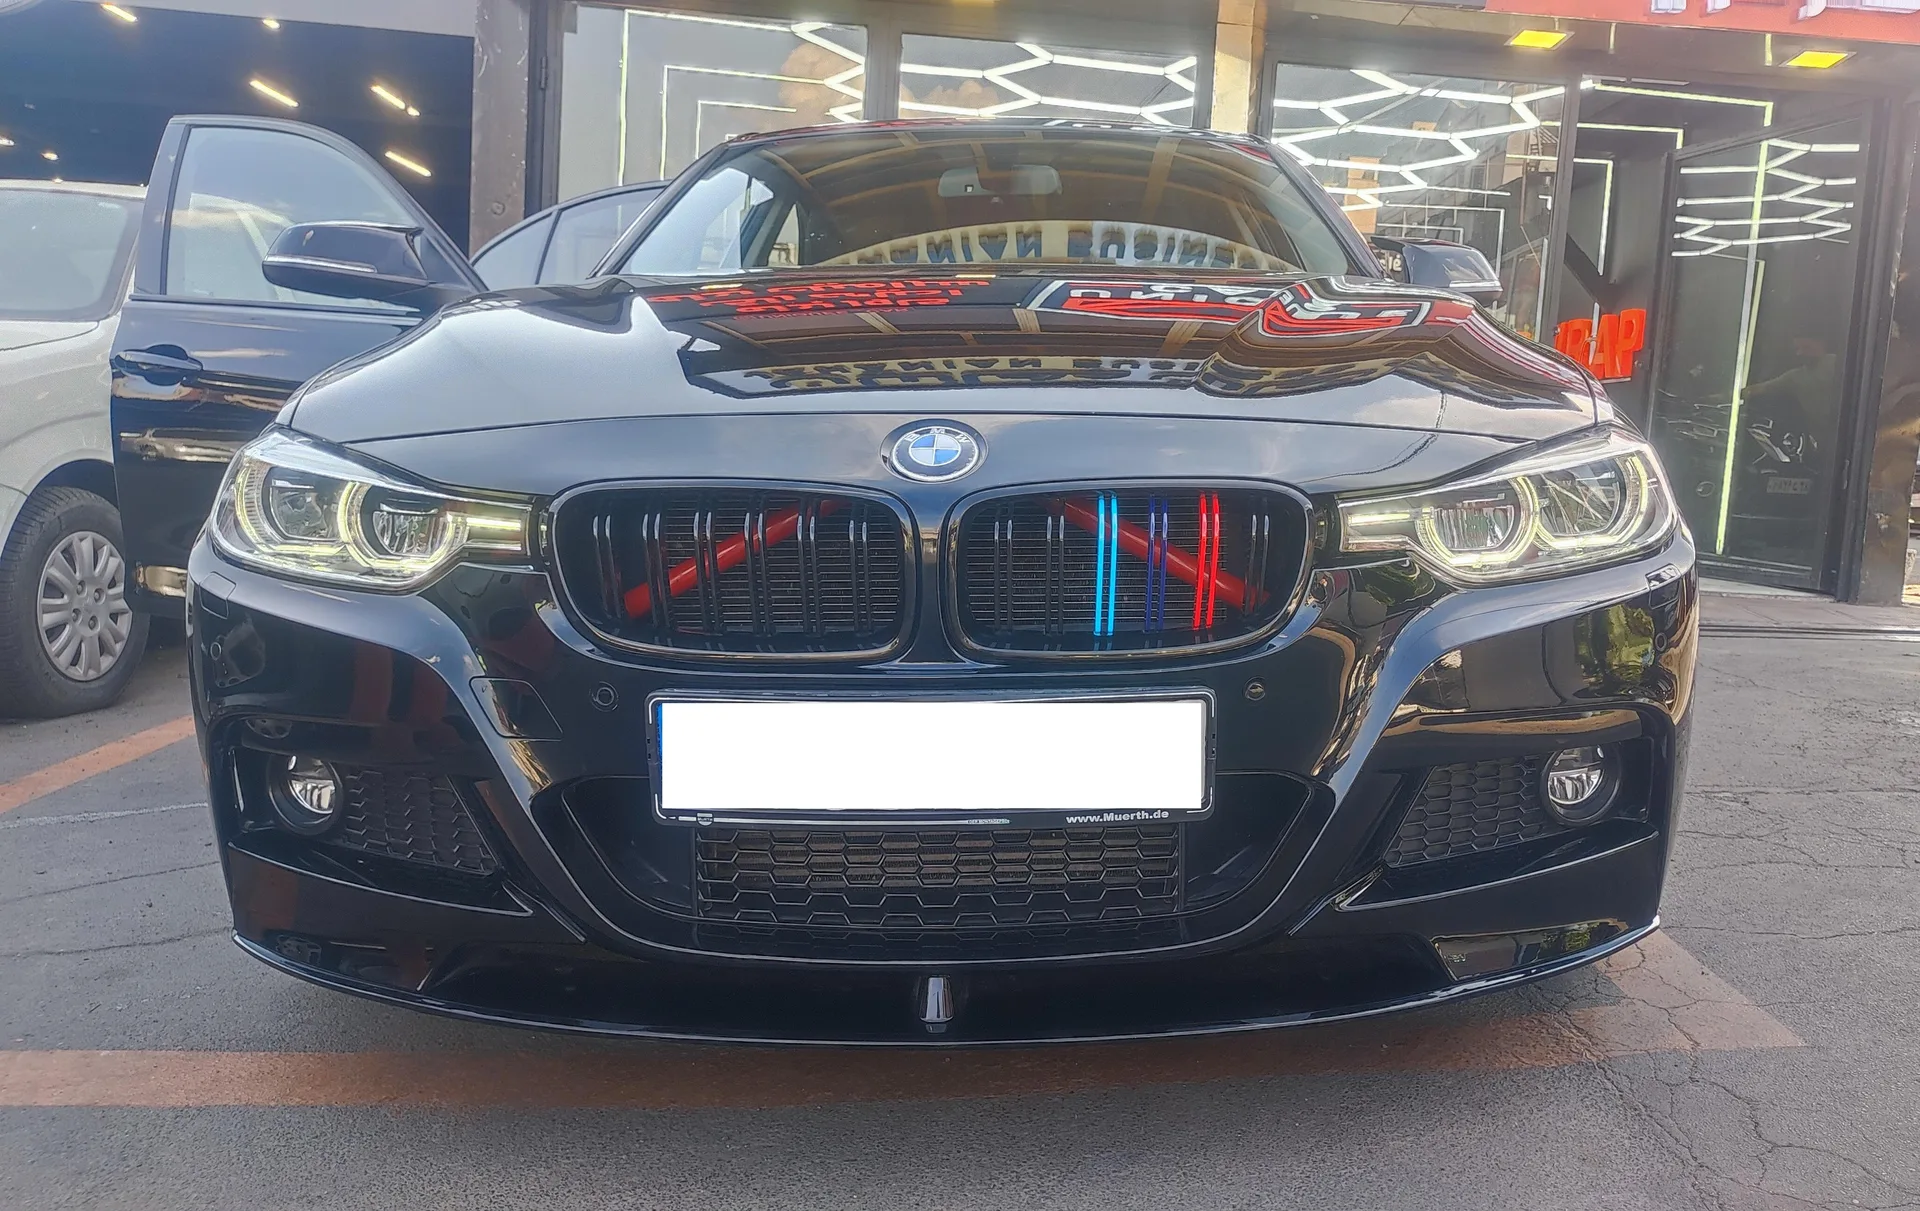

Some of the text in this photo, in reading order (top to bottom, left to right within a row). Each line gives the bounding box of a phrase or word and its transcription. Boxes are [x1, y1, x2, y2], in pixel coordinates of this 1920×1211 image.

[1555, 309, 1647, 378] RAP
[902, 427, 971, 444] BMW
[1066, 810, 1169, 823] www.Muerth.de
